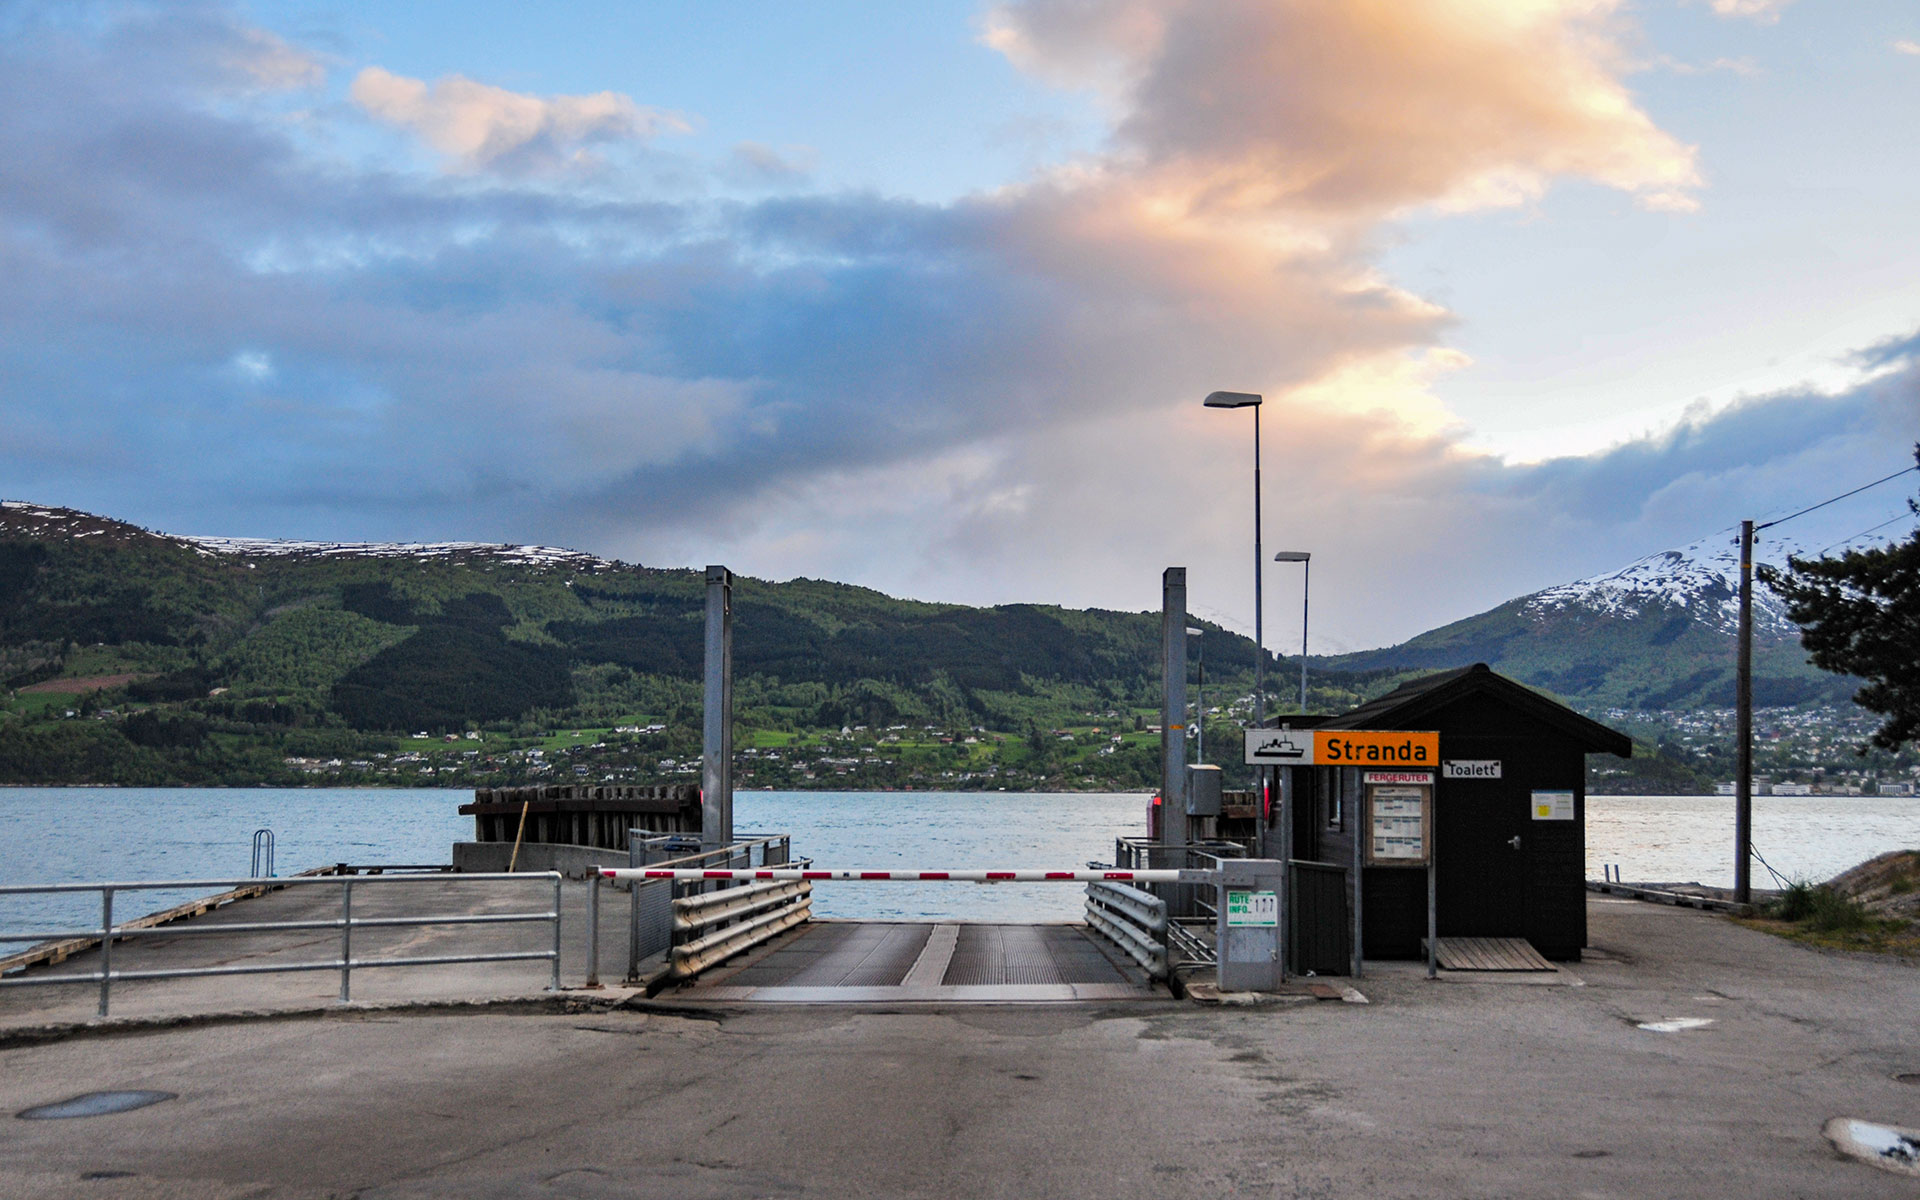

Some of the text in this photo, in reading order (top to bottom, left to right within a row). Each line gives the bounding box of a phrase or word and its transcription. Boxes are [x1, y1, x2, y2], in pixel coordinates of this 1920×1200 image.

[1327, 738, 1427, 761] Stranda
[1449, 763, 1495, 776] Toalett
[1368, 773, 1429, 782] FERGERUTER
